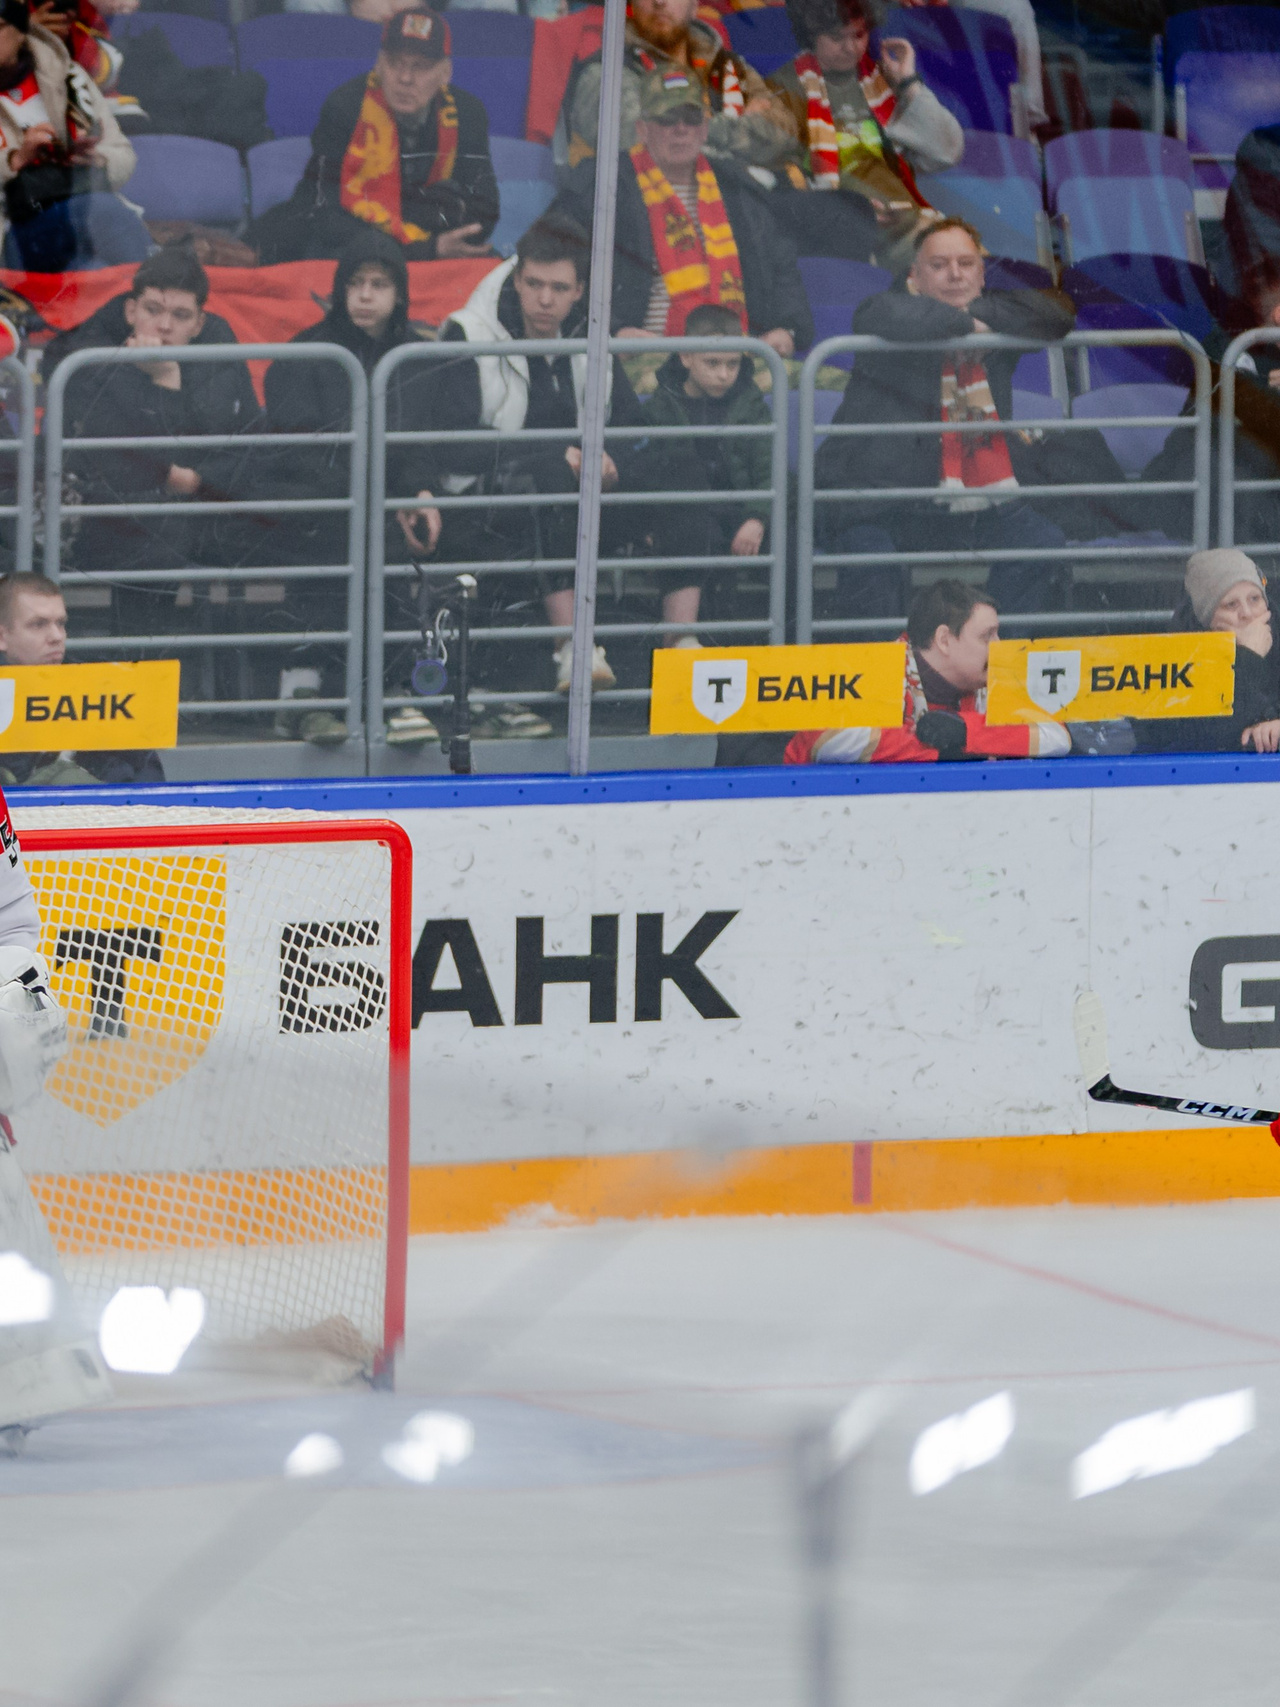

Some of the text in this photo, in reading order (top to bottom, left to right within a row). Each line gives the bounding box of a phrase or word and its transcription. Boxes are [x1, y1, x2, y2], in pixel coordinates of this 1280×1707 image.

[757, 674, 862, 702] БАНК
[1091, 663, 1194, 692] БАНК
[25, 693, 134, 722] БАНК
[278, 910, 741, 1034] БАНК
[1176, 1100, 1260, 1121] CCM
